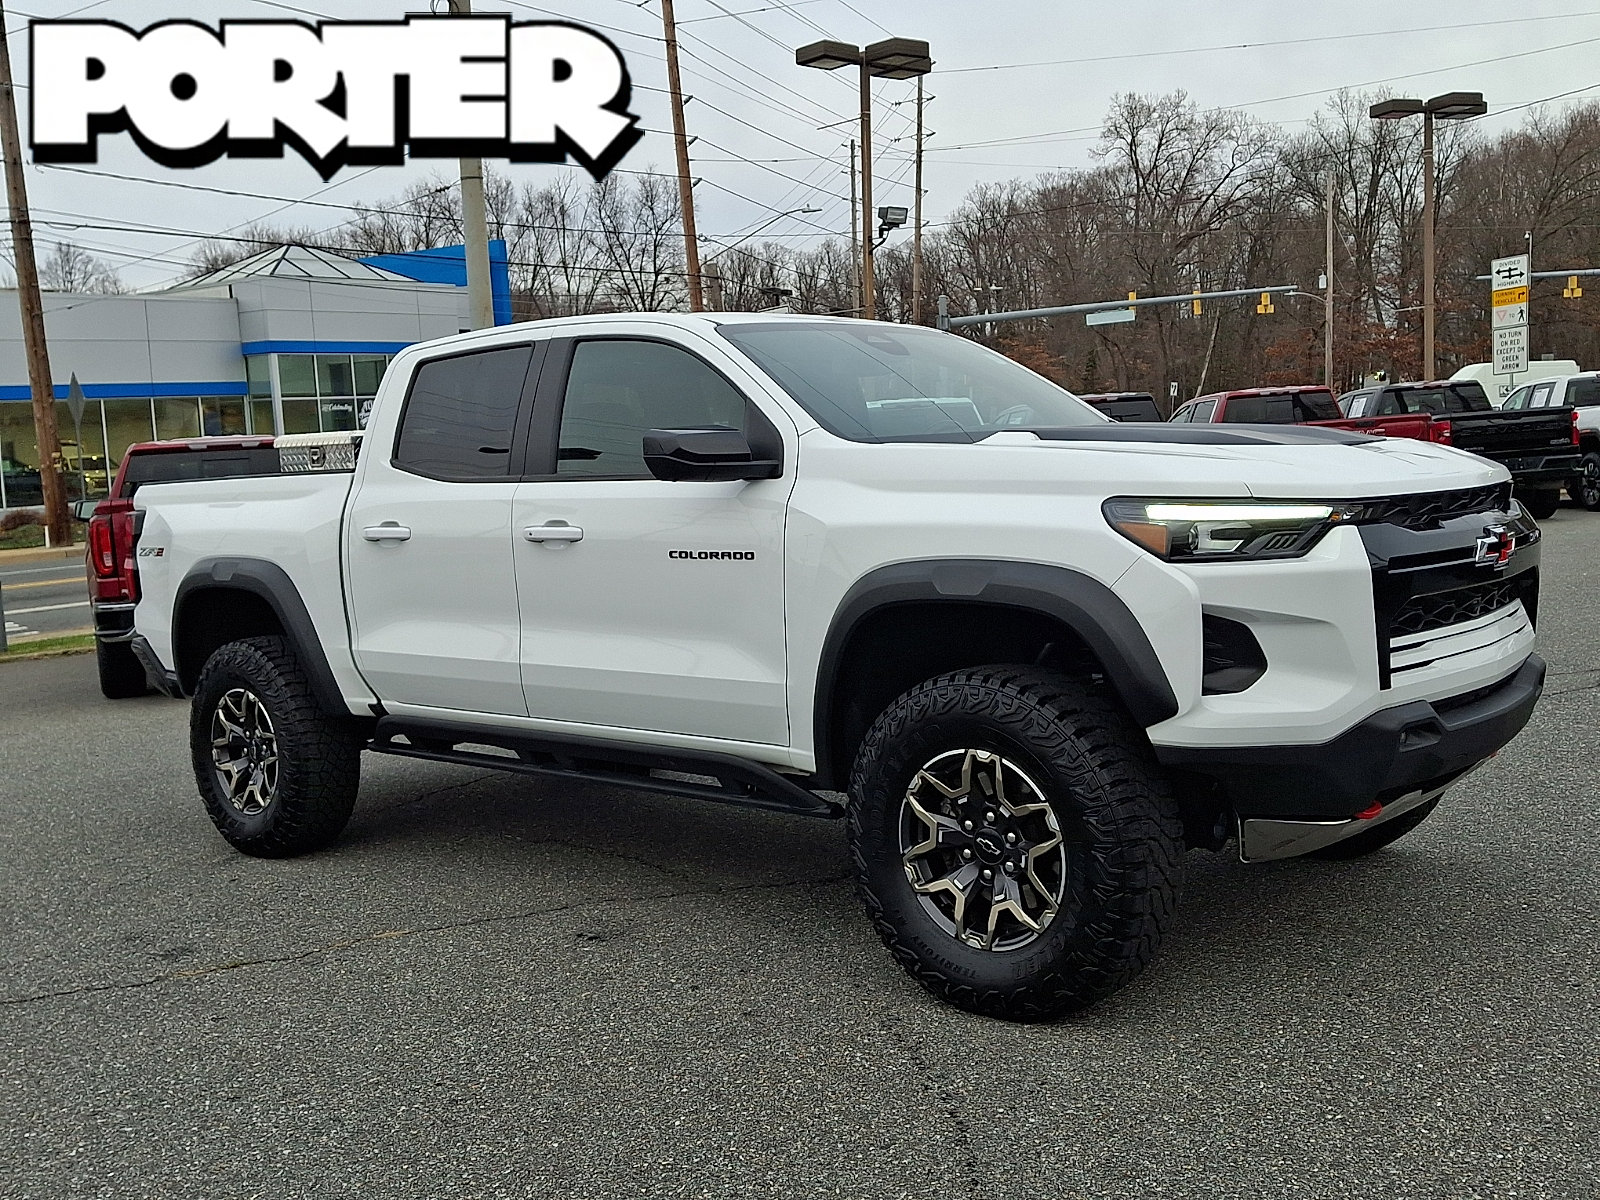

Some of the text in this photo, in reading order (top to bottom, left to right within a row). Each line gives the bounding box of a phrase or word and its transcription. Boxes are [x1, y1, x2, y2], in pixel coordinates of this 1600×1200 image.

[1498, 259, 1521, 268] DIVIDED
[1497, 279, 1523, 287] HIGHWAY
[1510, 338, 1521, 346] RED
[1496, 346, 1516, 356] EXCEPT
[1501, 354, 1520, 363] GREEN
[1501, 363, 1520, 371] ARROW
[139, 547, 165, 557] ZR2
[668, 550, 755, 561] COLORADO
